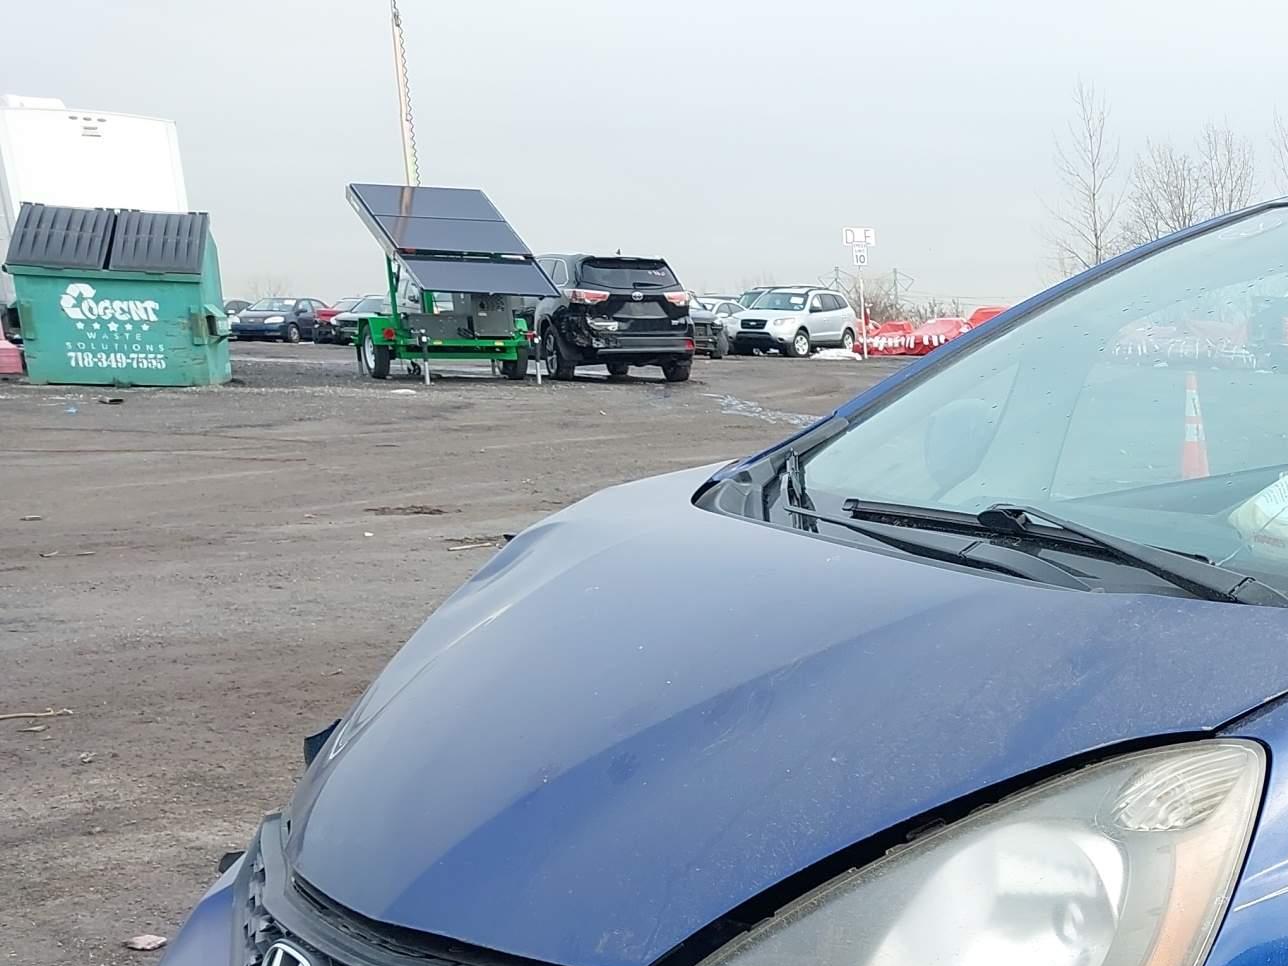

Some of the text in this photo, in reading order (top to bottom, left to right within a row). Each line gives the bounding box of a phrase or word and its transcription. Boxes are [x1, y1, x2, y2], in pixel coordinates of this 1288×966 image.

[855, 254, 866, 264] 10
[86, 331, 142, 341] WASTE
[65, 342, 165, 352] SOLUTIONS
[67, 351, 167, 369] 718-349-7555
